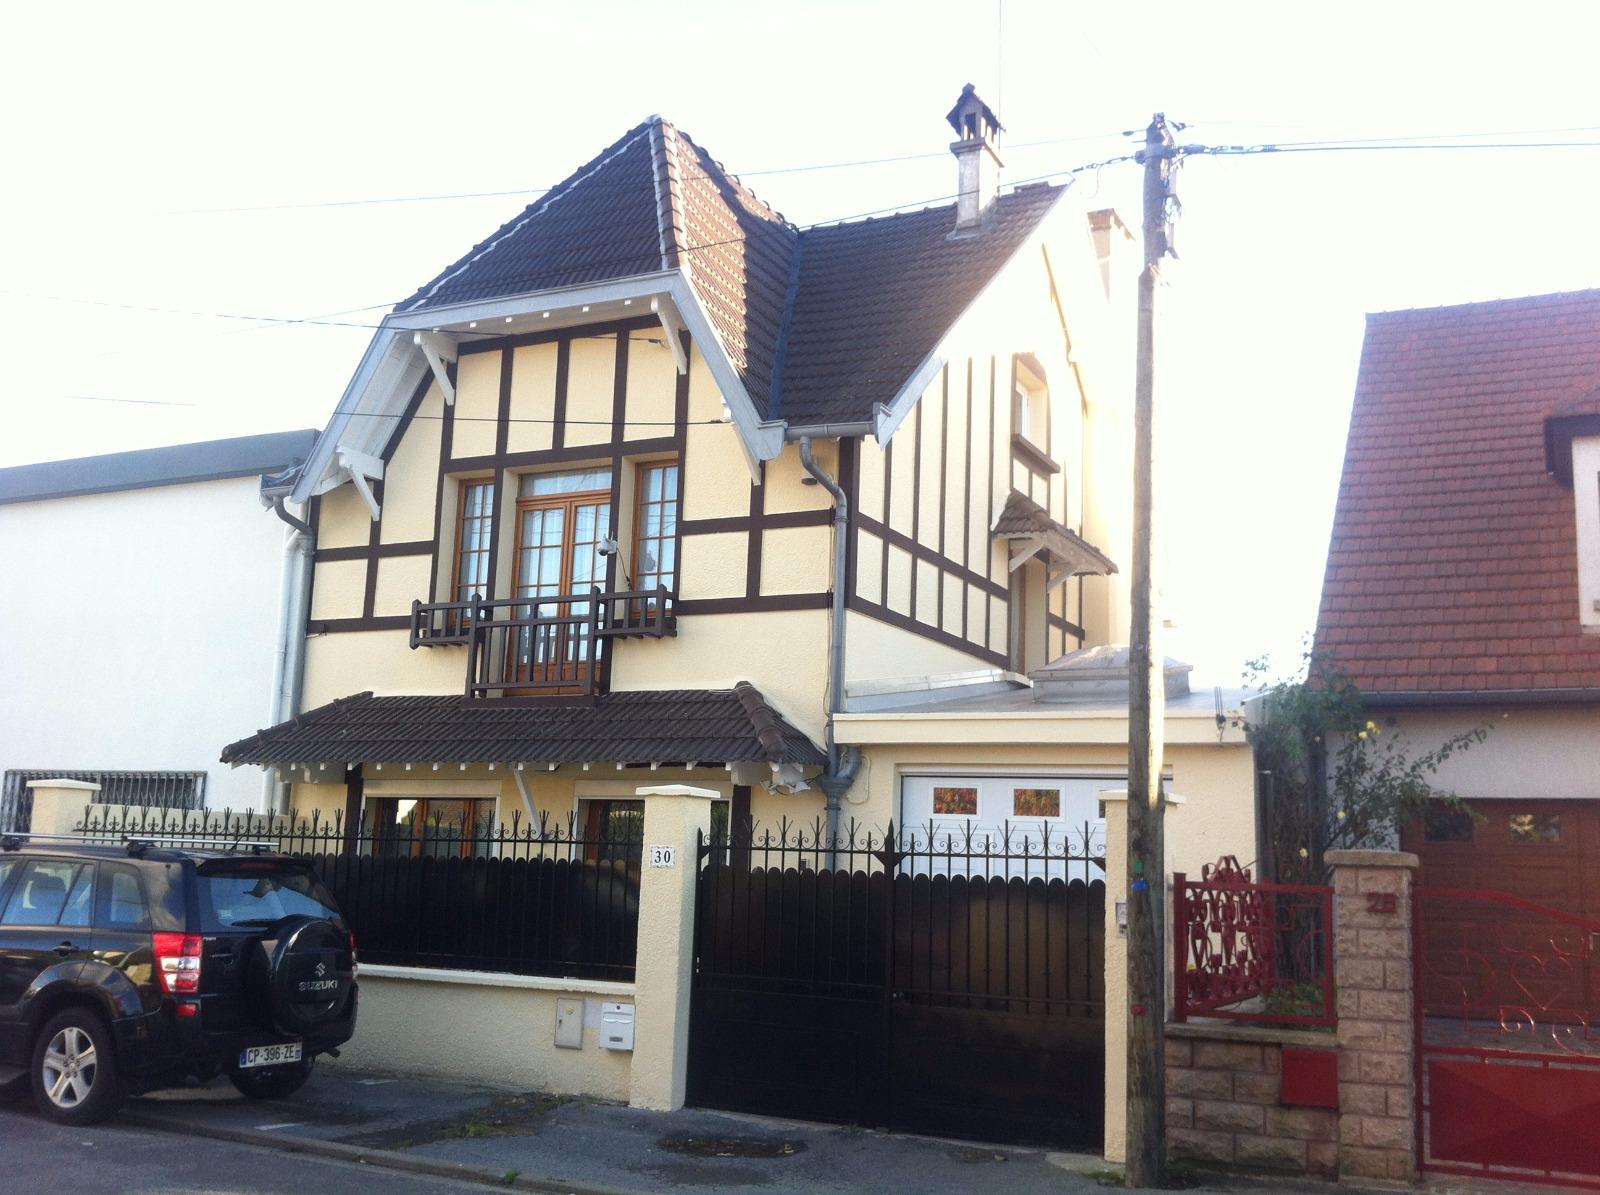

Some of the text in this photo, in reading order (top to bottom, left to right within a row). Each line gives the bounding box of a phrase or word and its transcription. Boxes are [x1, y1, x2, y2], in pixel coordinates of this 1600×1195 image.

[654, 850, 671, 864] 30
[299, 979, 338, 992] SUZUKI
[247, 1045, 295, 1063] CP-396-ZE
